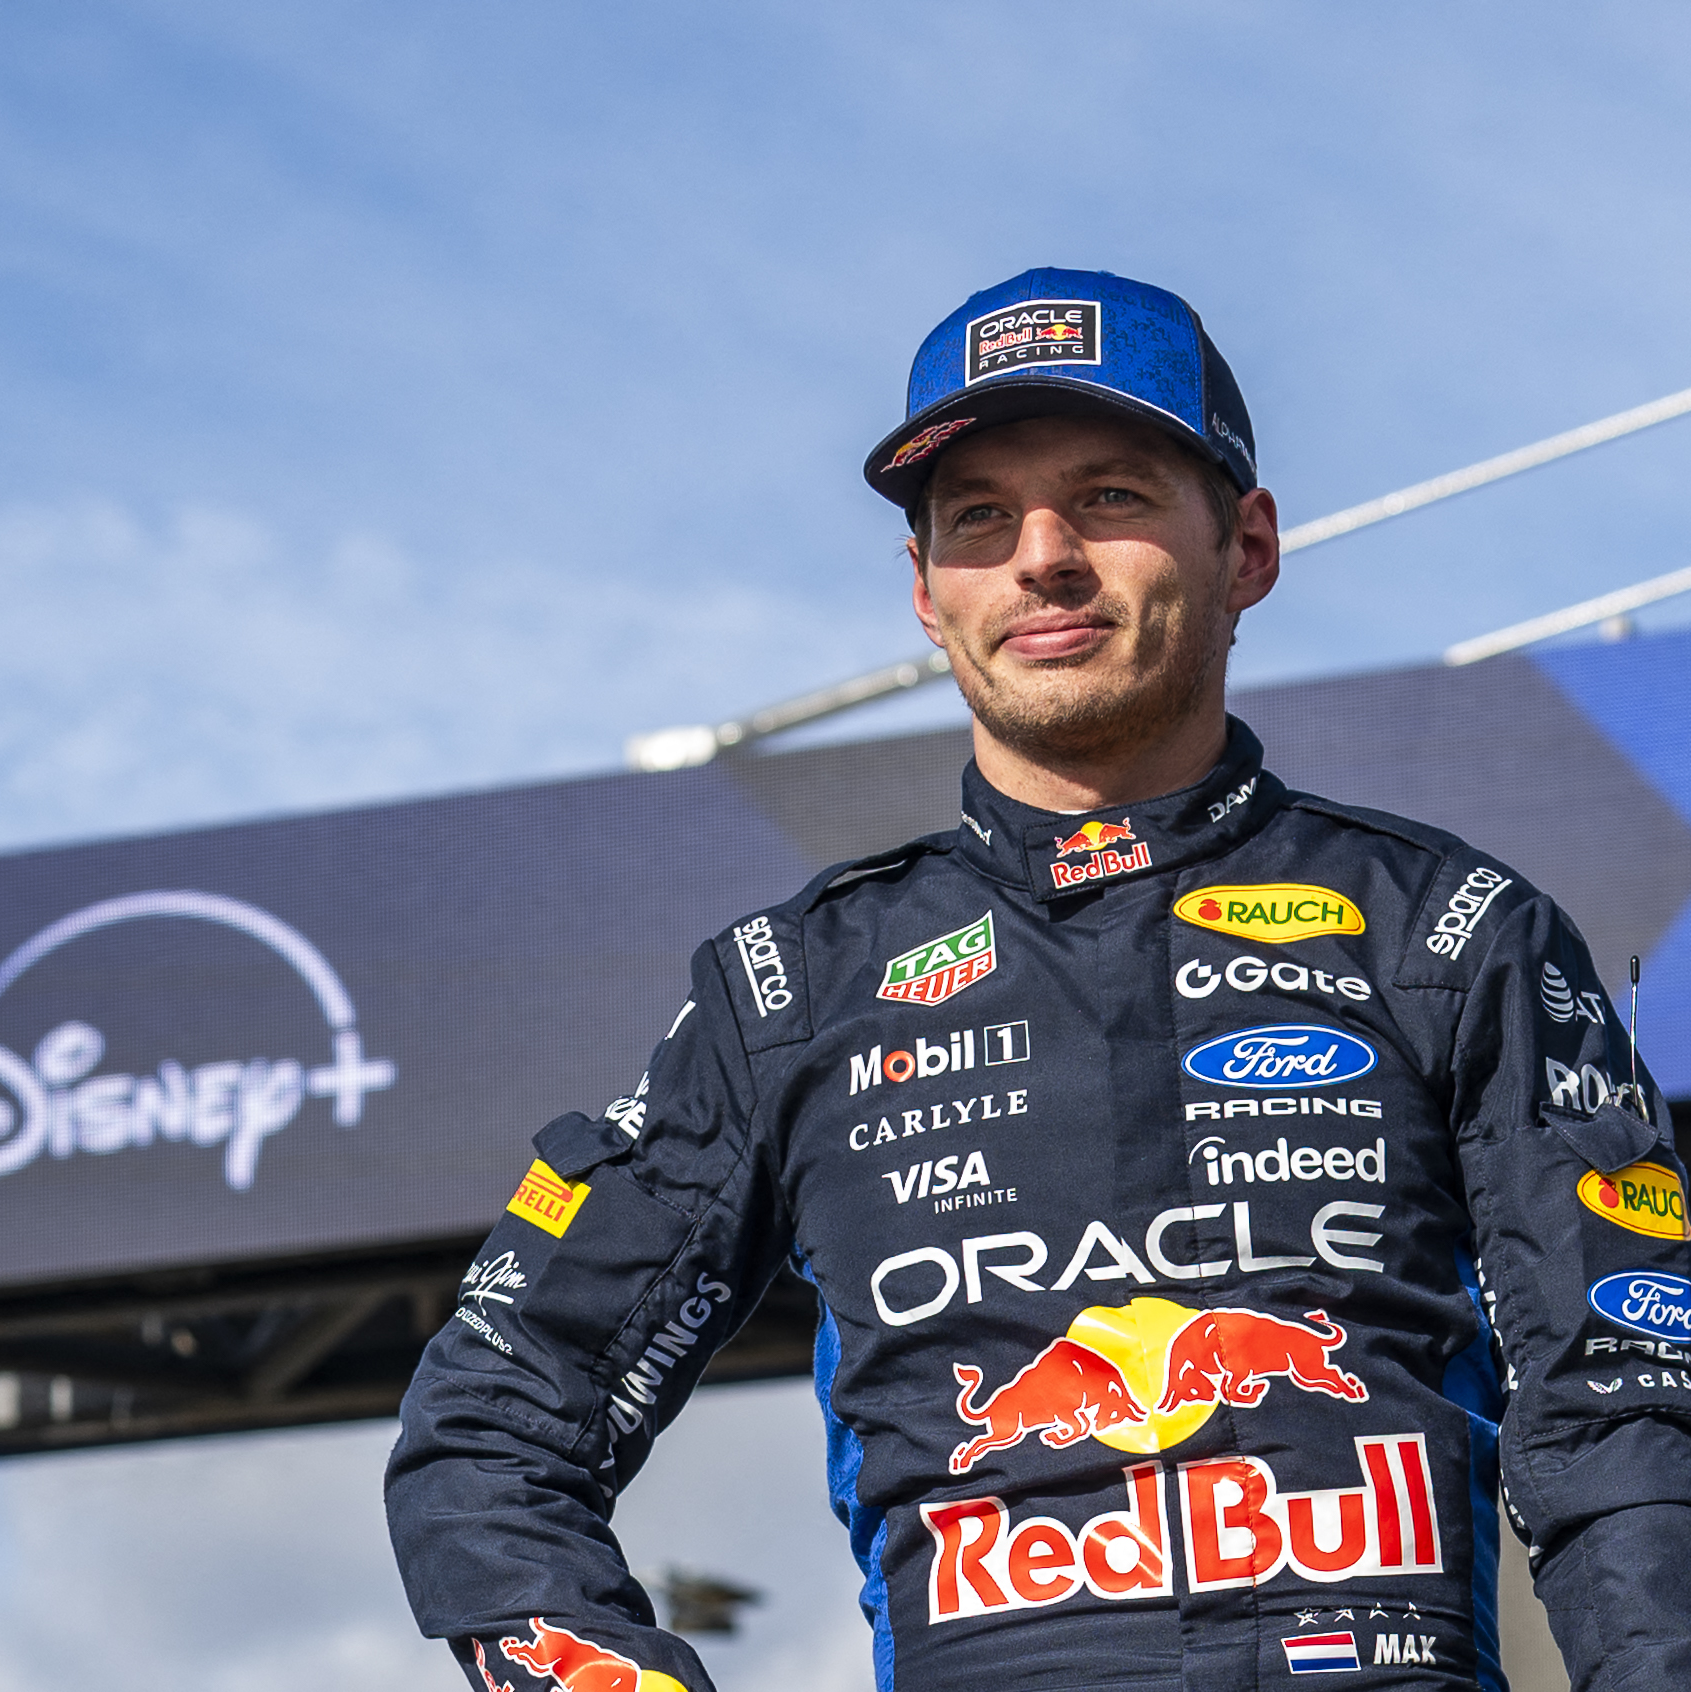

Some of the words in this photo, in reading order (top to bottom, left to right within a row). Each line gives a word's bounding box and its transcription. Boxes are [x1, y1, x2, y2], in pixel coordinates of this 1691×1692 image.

[979, 309, 1083, 339] ORACLE
[979, 331, 1005, 356] Red
[1005, 326, 1033, 348] Bull
[979, 345, 1084, 371] RACING
[1208, 777, 1258, 823] DAM
[1050, 853, 1102, 888] Red
[1103, 842, 1152, 877] Bull
[1227, 901, 1344, 926] RAUCH
[1427, 867, 1508, 959] sparco
[735, 916, 793, 1013] sparco
[896, 925, 987, 981] TAG
[884, 954, 992, 1003] HEUER
[1225, 956, 1372, 1001] Gate
[849, 1029, 975, 1096] Mobil
[1222, 1035, 1340, 1079] Ford
[849, 1089, 1029, 1151] CARLYLE
[1185, 1096, 1383, 1122] RACING
[882, 1150, 991, 1204] VISA
[1201, 1137, 1386, 1186] indeed
[935, 1188, 1018, 1214] INFINITE
[871, 1201, 1385, 1326] ORACLE
[922, 1462, 1172, 1623] Red
[1179, 1433, 1442, 1592] Bull
[1373, 1633, 1437, 1665] MAX
